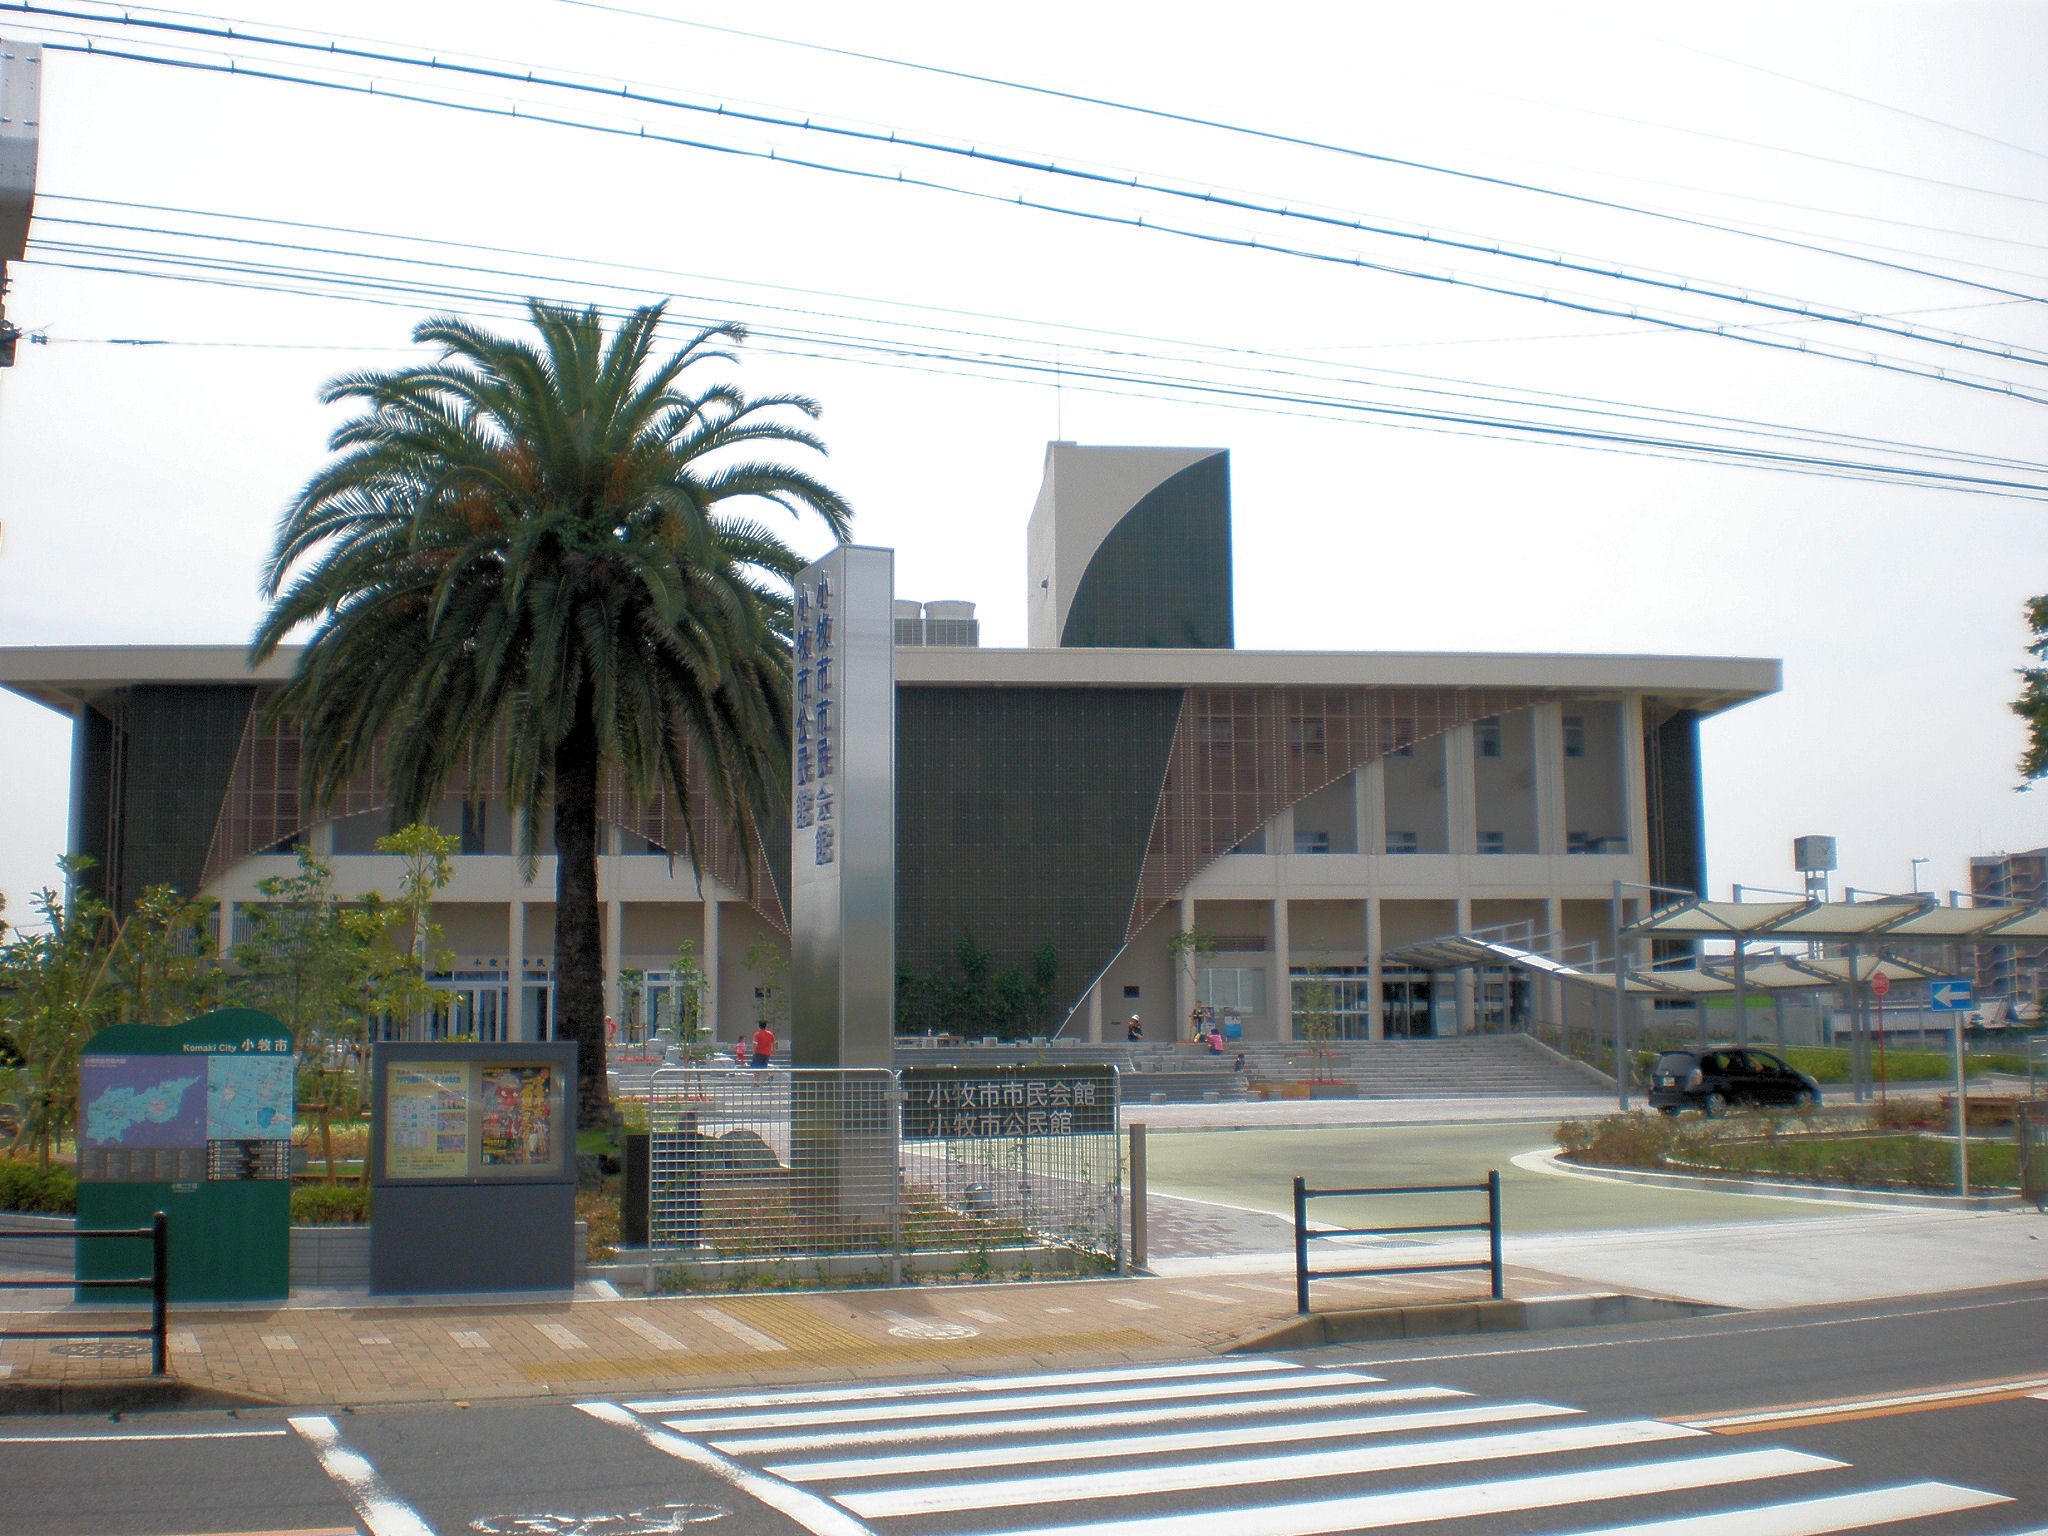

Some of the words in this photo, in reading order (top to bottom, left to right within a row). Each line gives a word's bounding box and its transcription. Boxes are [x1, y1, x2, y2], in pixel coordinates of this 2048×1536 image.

[797, 583, 814, 828] 小牧市公民館
[816, 569, 834, 865] 小牧市市民会館
[182, 1044, 216, 1052] Komaki
[218, 1044, 237, 1053] City
[241, 1038, 288, 1052] 小牧市
[927, 1081, 1096, 1108] 小牧市市民会館
[927, 1109, 1072, 1138] 小牧市公民館
